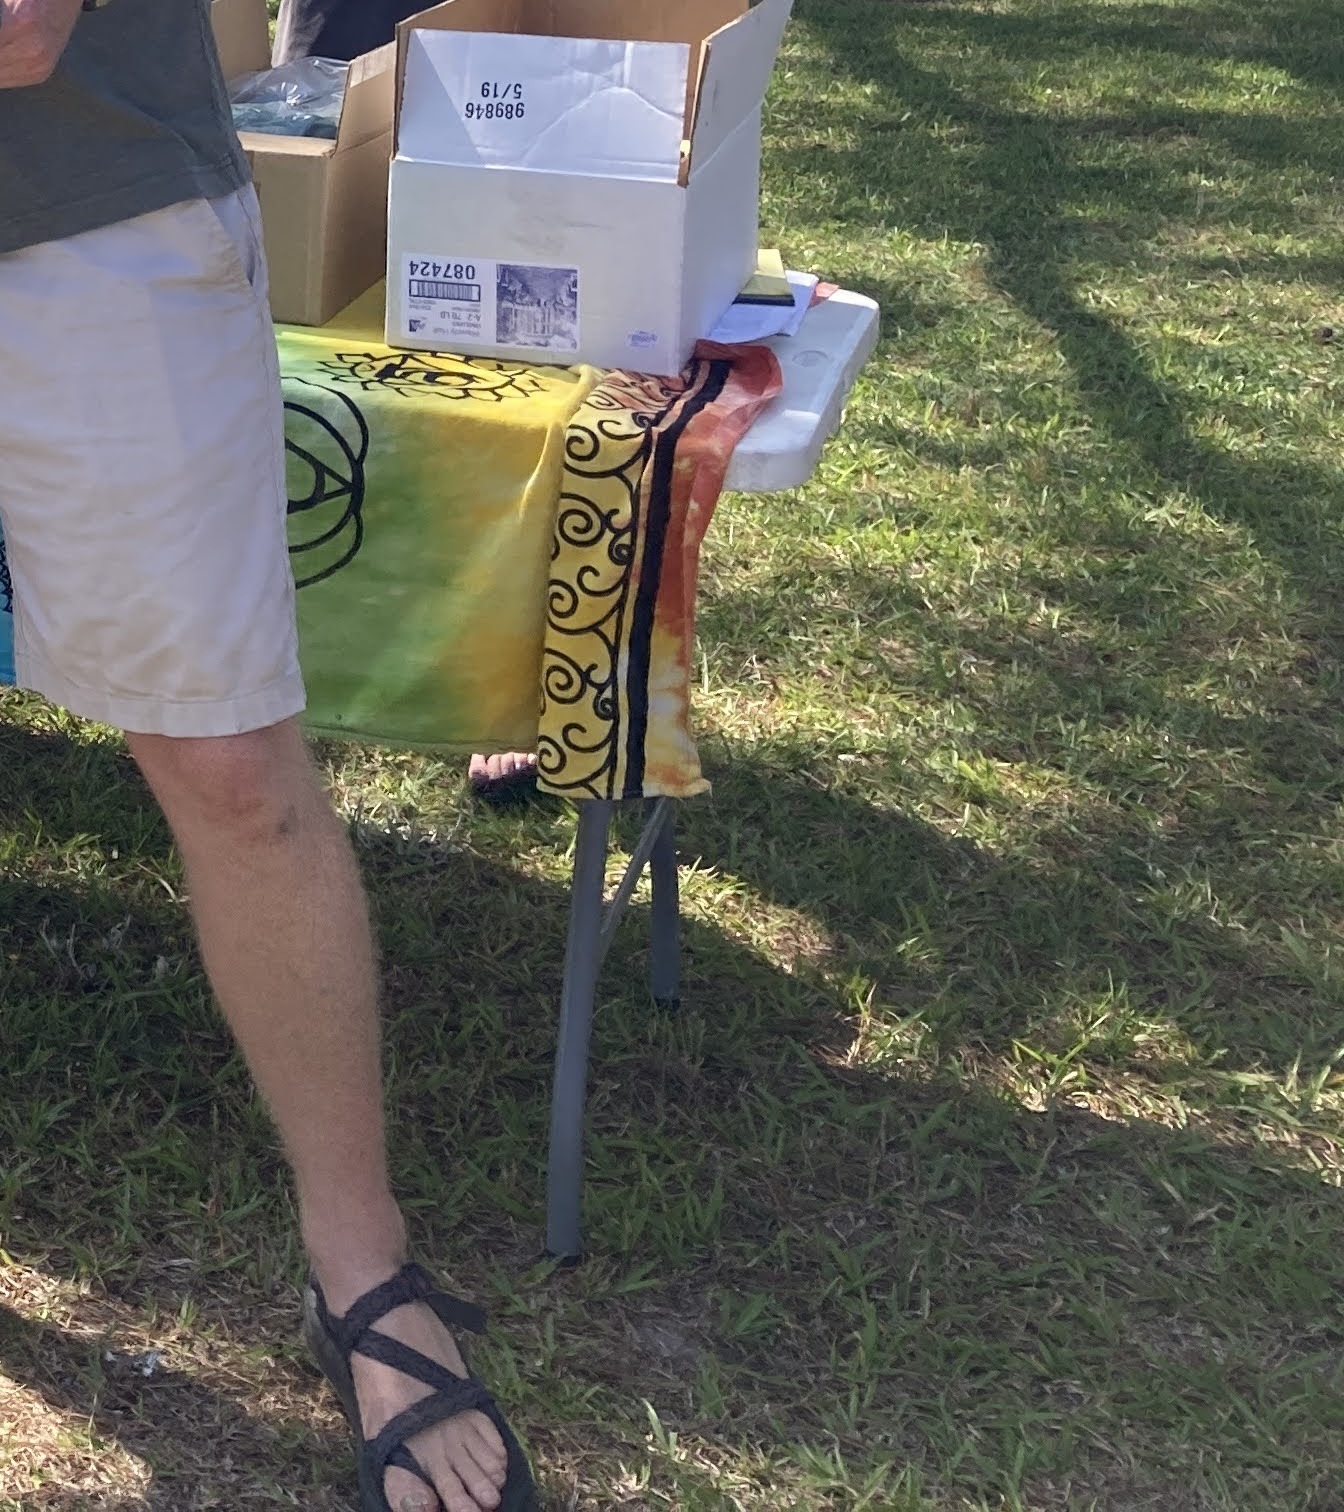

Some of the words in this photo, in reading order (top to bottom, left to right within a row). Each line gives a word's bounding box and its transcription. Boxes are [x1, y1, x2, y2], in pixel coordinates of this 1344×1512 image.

[481, 81, 523, 99] 5/19
[464, 102, 525, 120] 989846
[408, 260, 476, 280] 087424
